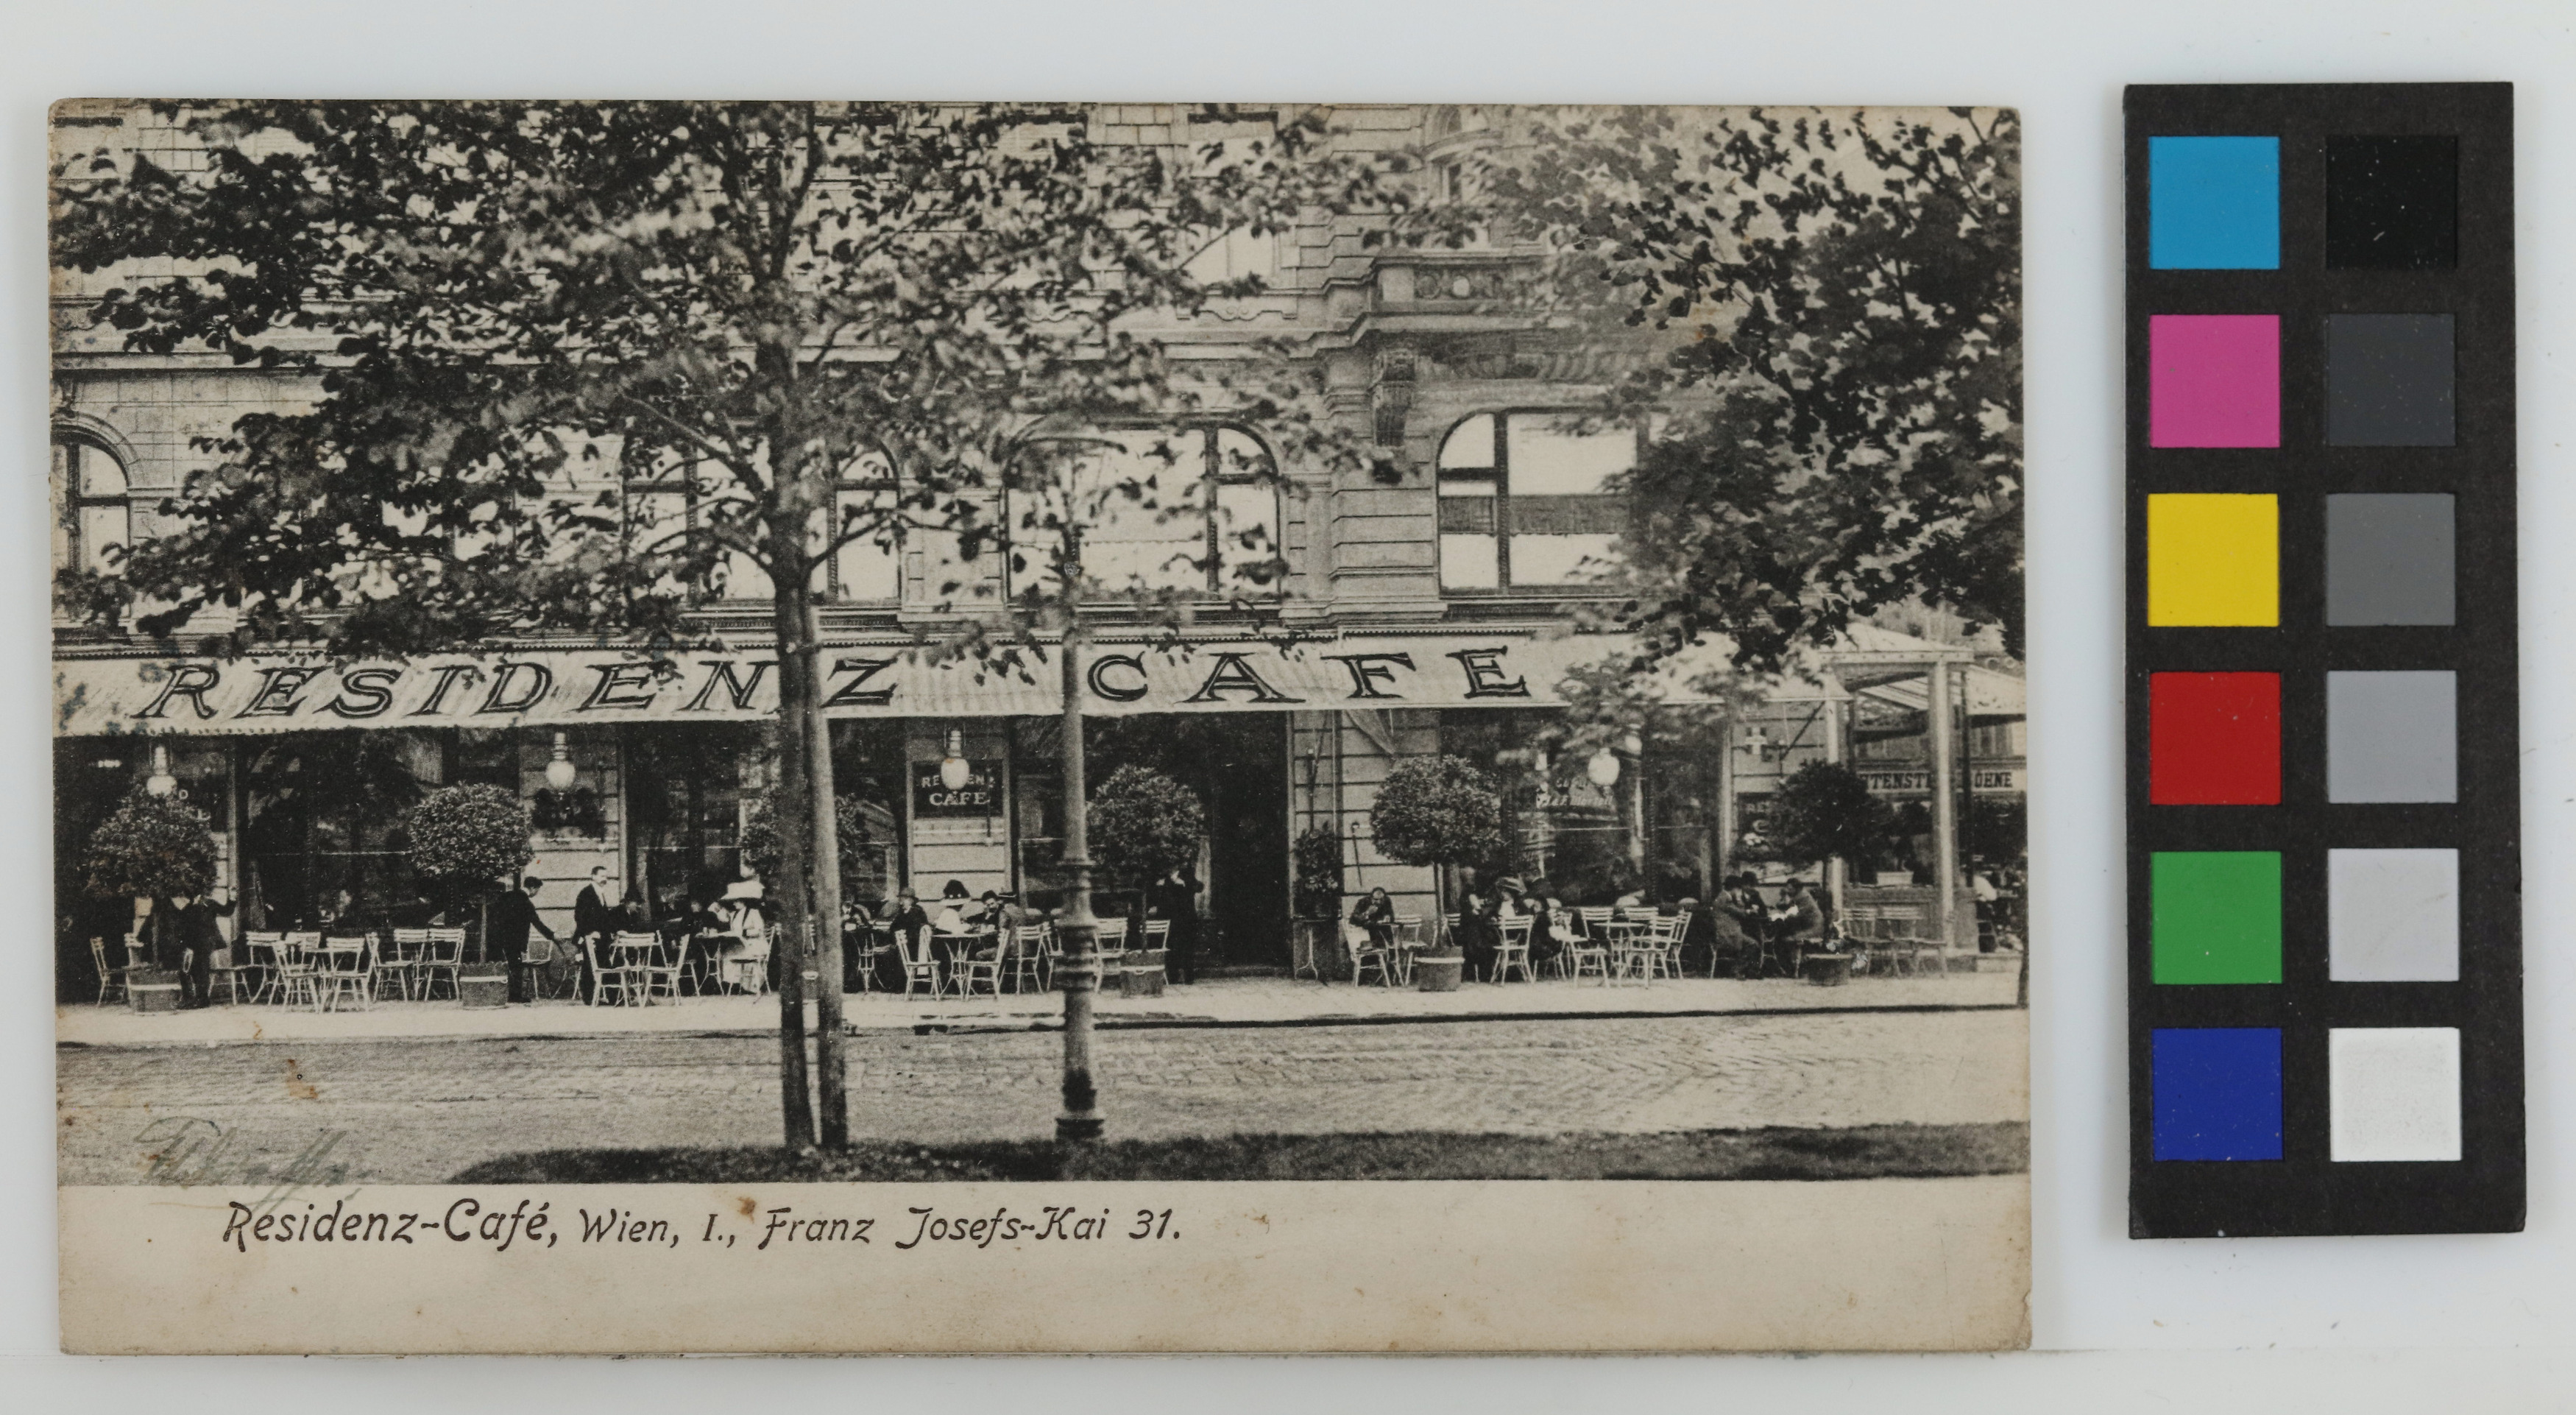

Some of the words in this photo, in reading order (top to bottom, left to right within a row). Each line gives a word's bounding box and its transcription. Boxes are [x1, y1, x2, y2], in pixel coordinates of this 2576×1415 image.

[130, 655, 904, 720] RESIDENZ
[1086, 645, 1531, 705] CAFE
[222, 1198, 558, 1252] Residenz-Café,
[578, 1207, 679, 1249] Wien,
[757, 1206, 876, 1250] Franz
[894, 1205, 1110, 1250] Josefs-Kai
[1128, 1208, 1180, 1240] 31.
